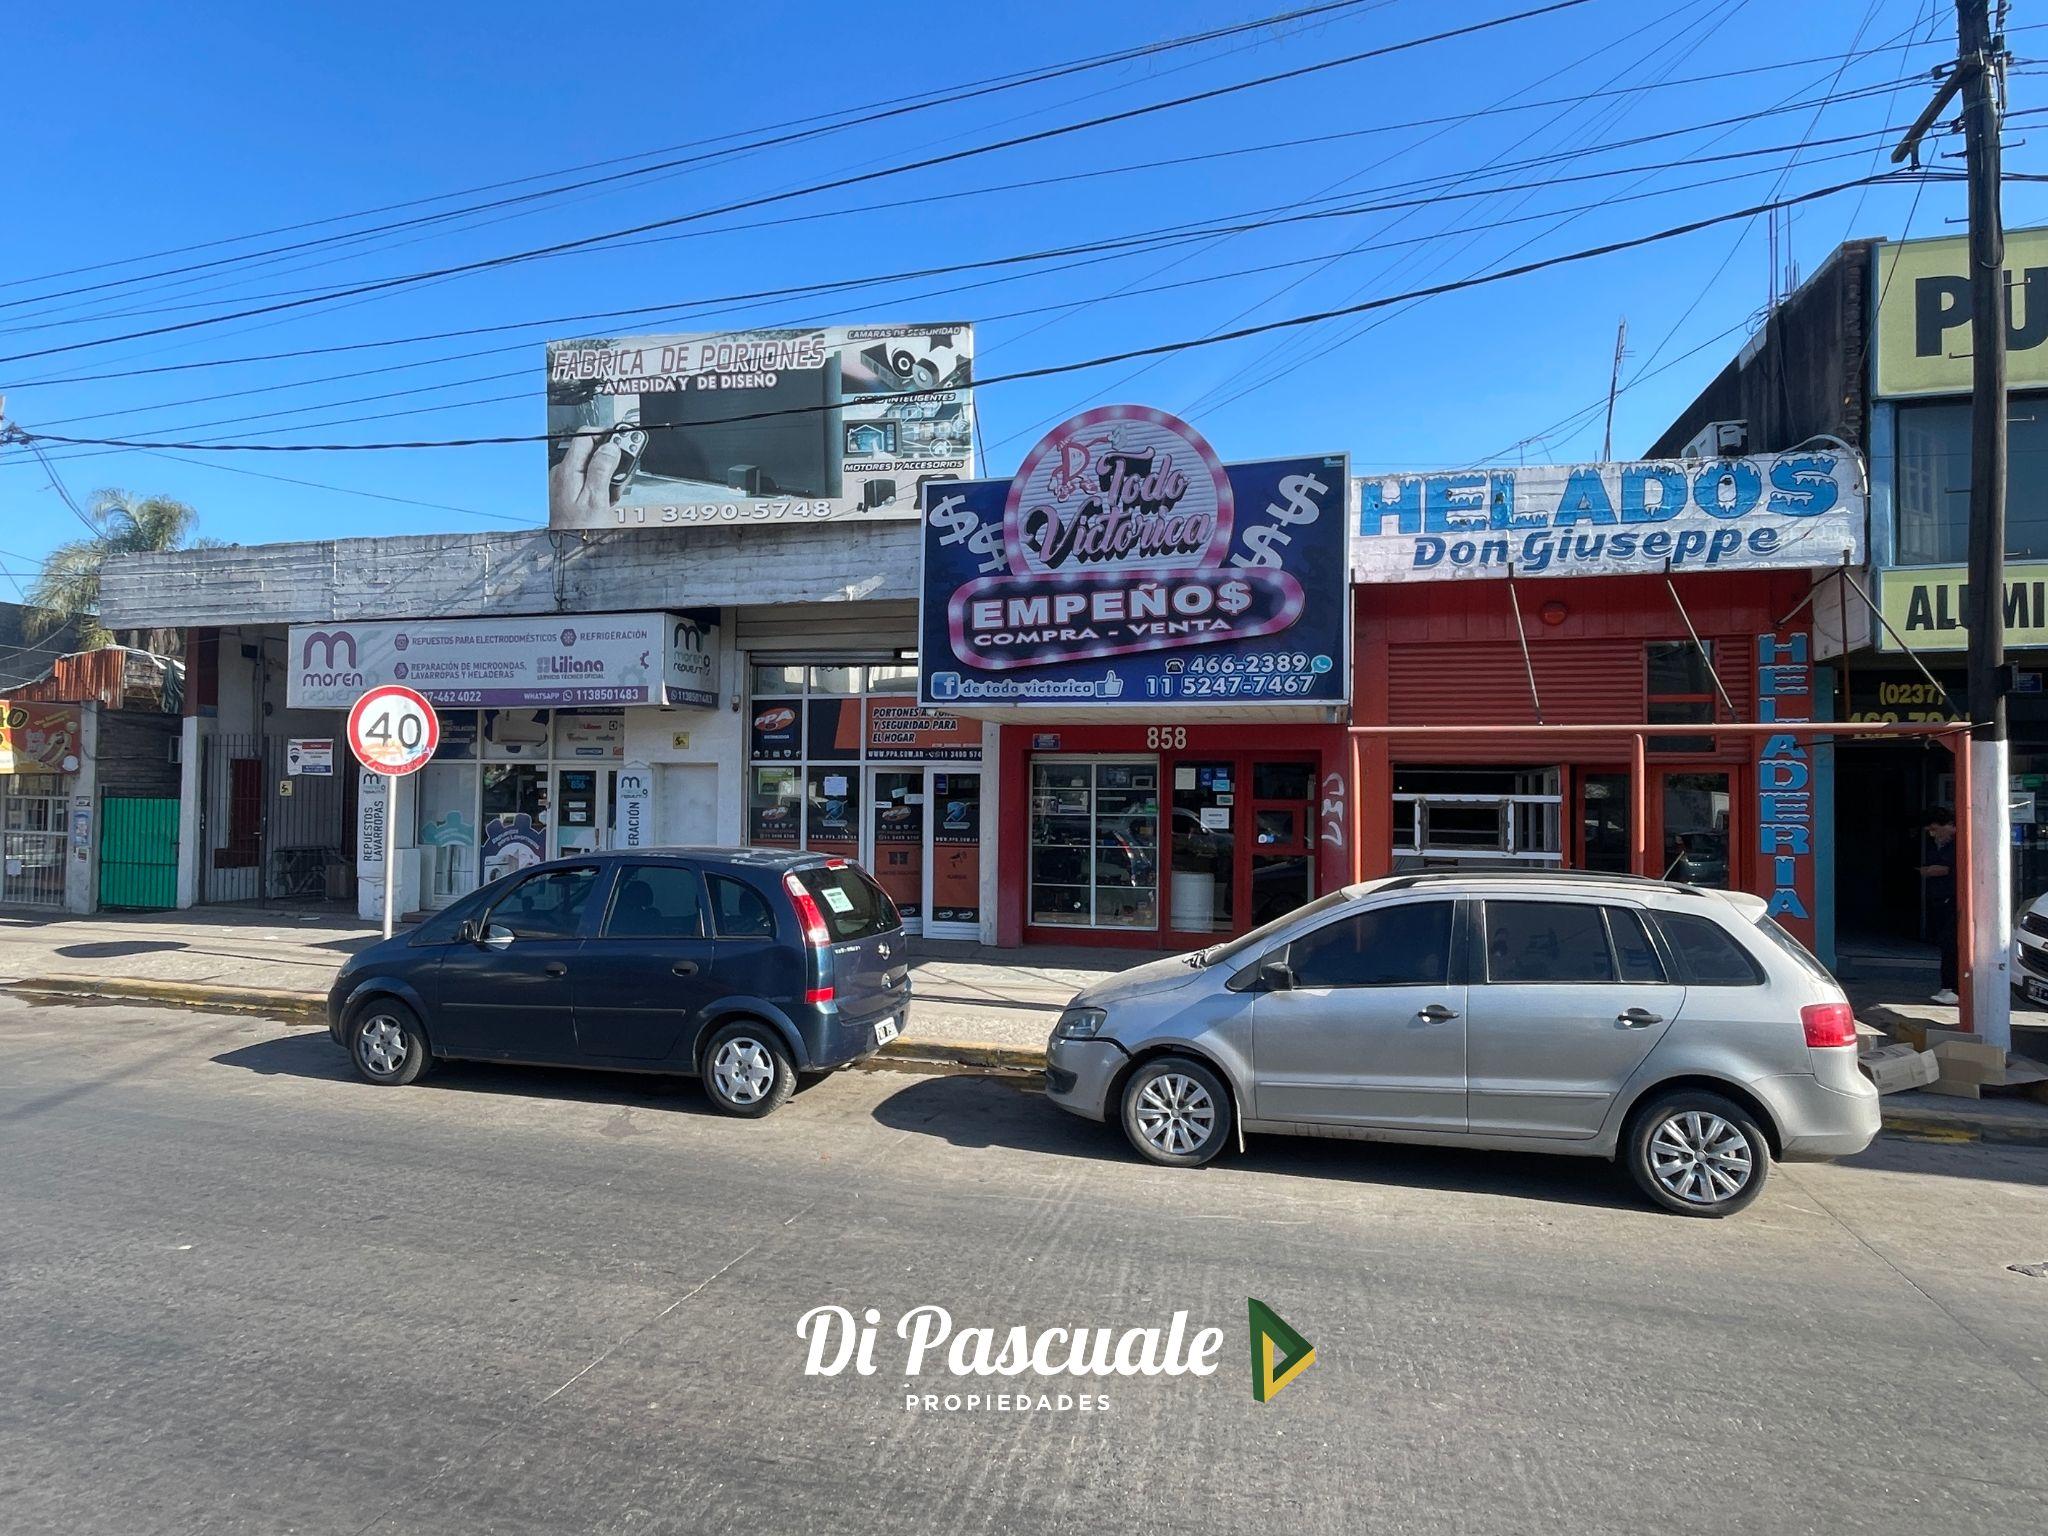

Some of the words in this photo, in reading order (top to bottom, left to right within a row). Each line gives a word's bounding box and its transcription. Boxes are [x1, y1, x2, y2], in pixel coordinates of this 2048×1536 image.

[848, 329, 891, 340] CAMARAS
[552, 348, 644, 380] FABRICA
[660, 346, 690, 374] DE
[699, 336, 826, 372] PORTONES
[616, 376, 676, 394] MEDIDA
[677, 377, 689, 391] Y
[699, 376, 716, 390] DE
[721, 371, 778, 389] DISEÑO
[844, 463, 891, 472] MOTORES
[895, 463, 902, 471] Y
[902, 460, 964, 470] ACCESORIOS
[1095, 446, 1191, 510] Todo
[1360, 452, 1839, 536] HELADOS
[615, 507, 645, 522] 11
[661, 501, 832, 522] 3490-5748
[1023, 495, 1213, 568] Victorica
[1413, 535, 1508, 570] Don
[1521, 526, 1781, 572] Giuseppe
[412, 636, 454, 646] REPUESTOS
[455, 636, 475, 645] PARA
[476, 632, 557, 645] ELECTRODOMÉSTICOS
[580, 630, 648, 641] REFRIGERACIÓN
[973, 626, 1099, 647] COMPRA
[1128, 617, 1232, 637] VENTA
[411, 662, 459, 672] REPARACIÓN
[461, 662, 470, 671] DE
[551, 655, 604, 673] Liliana
[1190, 654, 1307, 674] 466-2389
[411, 671, 459, 680] LAVARROPAS
[461, 671, 467, 679] Y
[468, 670, 514, 679] HELADERAS
[1147, 677, 1170, 694] 11
[1182, 675, 1314, 694] 5247-7467
[576, 688, 639, 701] 1138501483
[963, 681, 979, 693] de
[986, 681, 1019, 693] todo
[1025, 680, 1091, 693] victorica
[458, 691, 481, 702] 4022
[873, 707, 918, 718] PORTONES
[365, 712, 422, 749] 40
[873, 720, 879, 730] Y
[881, 719, 931, 730] SEGURIDAD
[932, 719, 957, 730] PARA
[872, 733, 882, 743] EL
[884, 732, 916, 743] HOGAR
[1147, 727, 1187, 750] 858
[363, 806, 373, 861] REPUESTOS
[373, 800, 384, 862] LAVARROPAS
[627, 801, 640, 847] ERACIÓN
